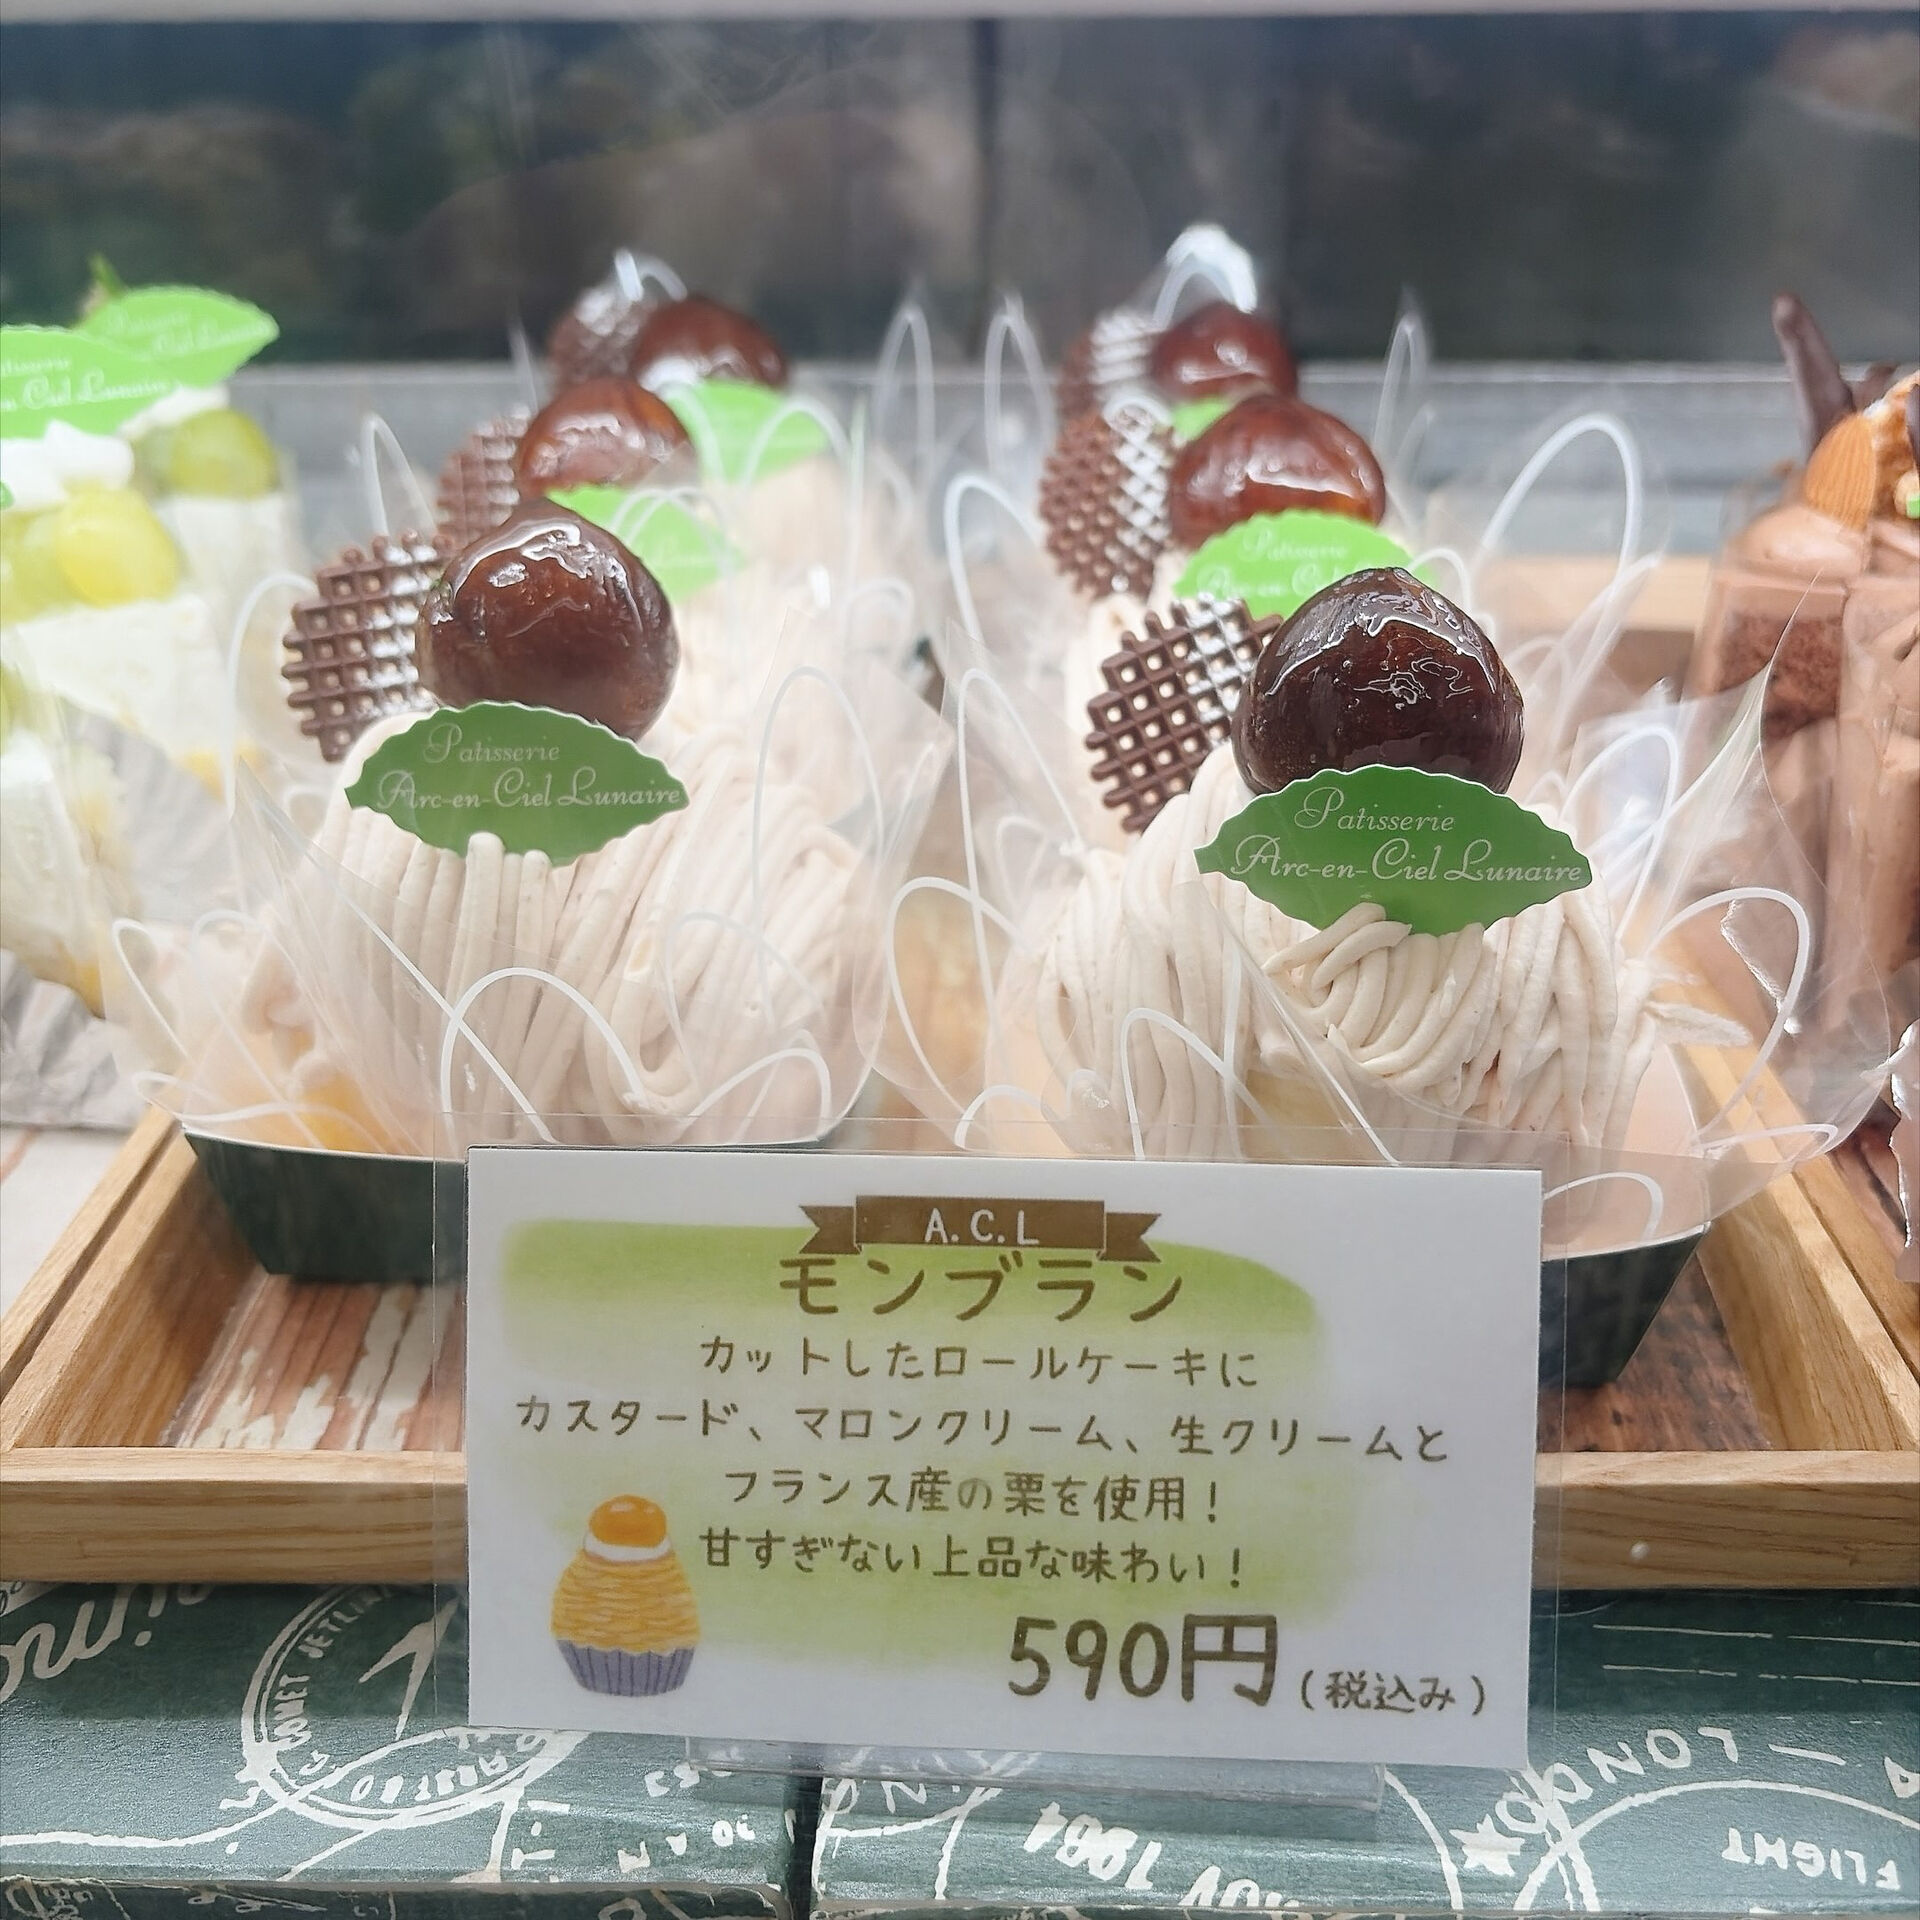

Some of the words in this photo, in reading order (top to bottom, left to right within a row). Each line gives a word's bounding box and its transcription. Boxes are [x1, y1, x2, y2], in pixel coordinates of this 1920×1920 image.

[423, 722, 561, 764] Patisserie
[557, 765, 682, 807] Lunaire
[1294, 786, 1455, 831] Patisserie
[1230, 833, 1440, 881] Arc-en-Ciel
[1443, 838, 1582, 882] Lunaire
[924, 1207, 1040, 1245] A.C.L
[778, 1250, 1183, 1323] モンブラン
[700, 1335, 1259, 1388] カットしたロールケーキに
[516, 1394, 1449, 1463] カスタード、マロンクリーム、生クリームと
[724, 1466, 1218, 1523] フランス産の栗を使用！
[698, 1526, 1242, 1589] 甘すぎない上品な味わい！
[1007, 1613, 1278, 1707] 590円
[1721, 1827, 1901, 1890] FLIGHT
